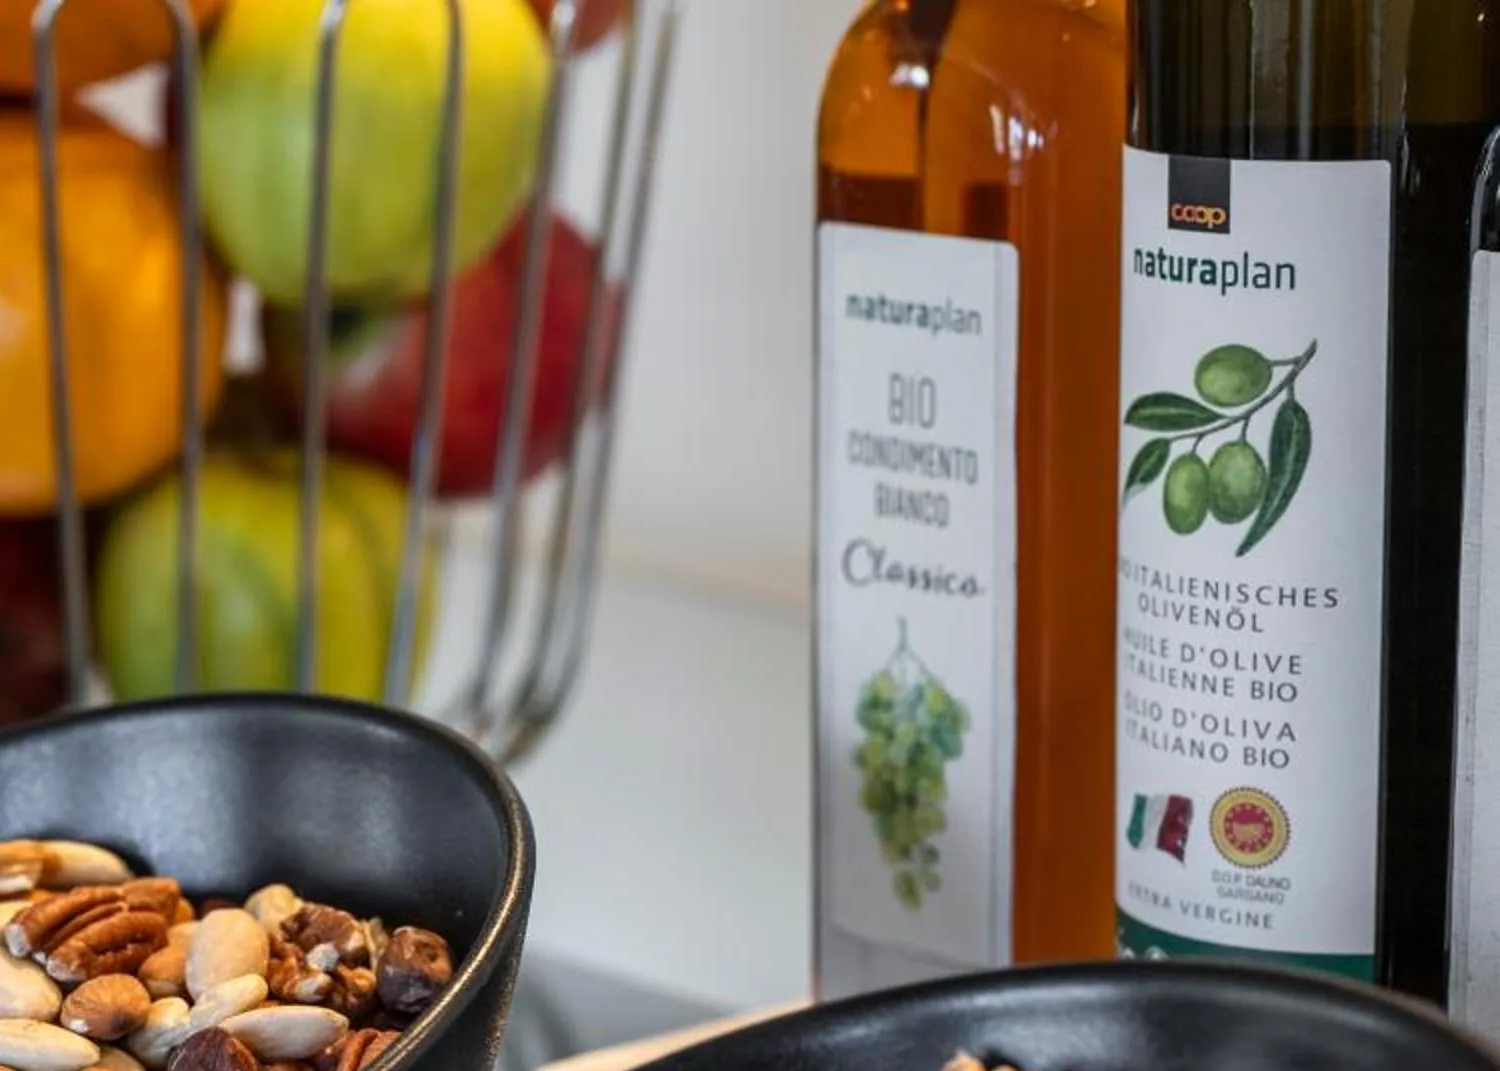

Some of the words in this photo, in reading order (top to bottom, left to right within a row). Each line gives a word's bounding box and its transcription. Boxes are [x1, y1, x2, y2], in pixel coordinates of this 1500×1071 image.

[1171, 204, 1227, 228] coop
[1133, 247, 1297, 297] naturaplan
[846, 293, 982, 338] naturaplan
[888, 372, 937, 429] BIO
[847, 429, 979, 485] CONDIMENTO
[874, 483, 950, 528] BIANCO
[841, 537, 985, 598] Classico
[1132, 562, 1339, 609] ITALIENISCHES
[1137, 592, 1264, 633] OLIVENÖL
[1180, 642, 1303, 676] D'OLIVE
[1250, 680, 1298, 703] BIO
[1172, 707, 1297, 742] D'OLIVA
[1243, 746, 1290, 769] BIO
[1180, 900, 1275, 930] VERGINE
